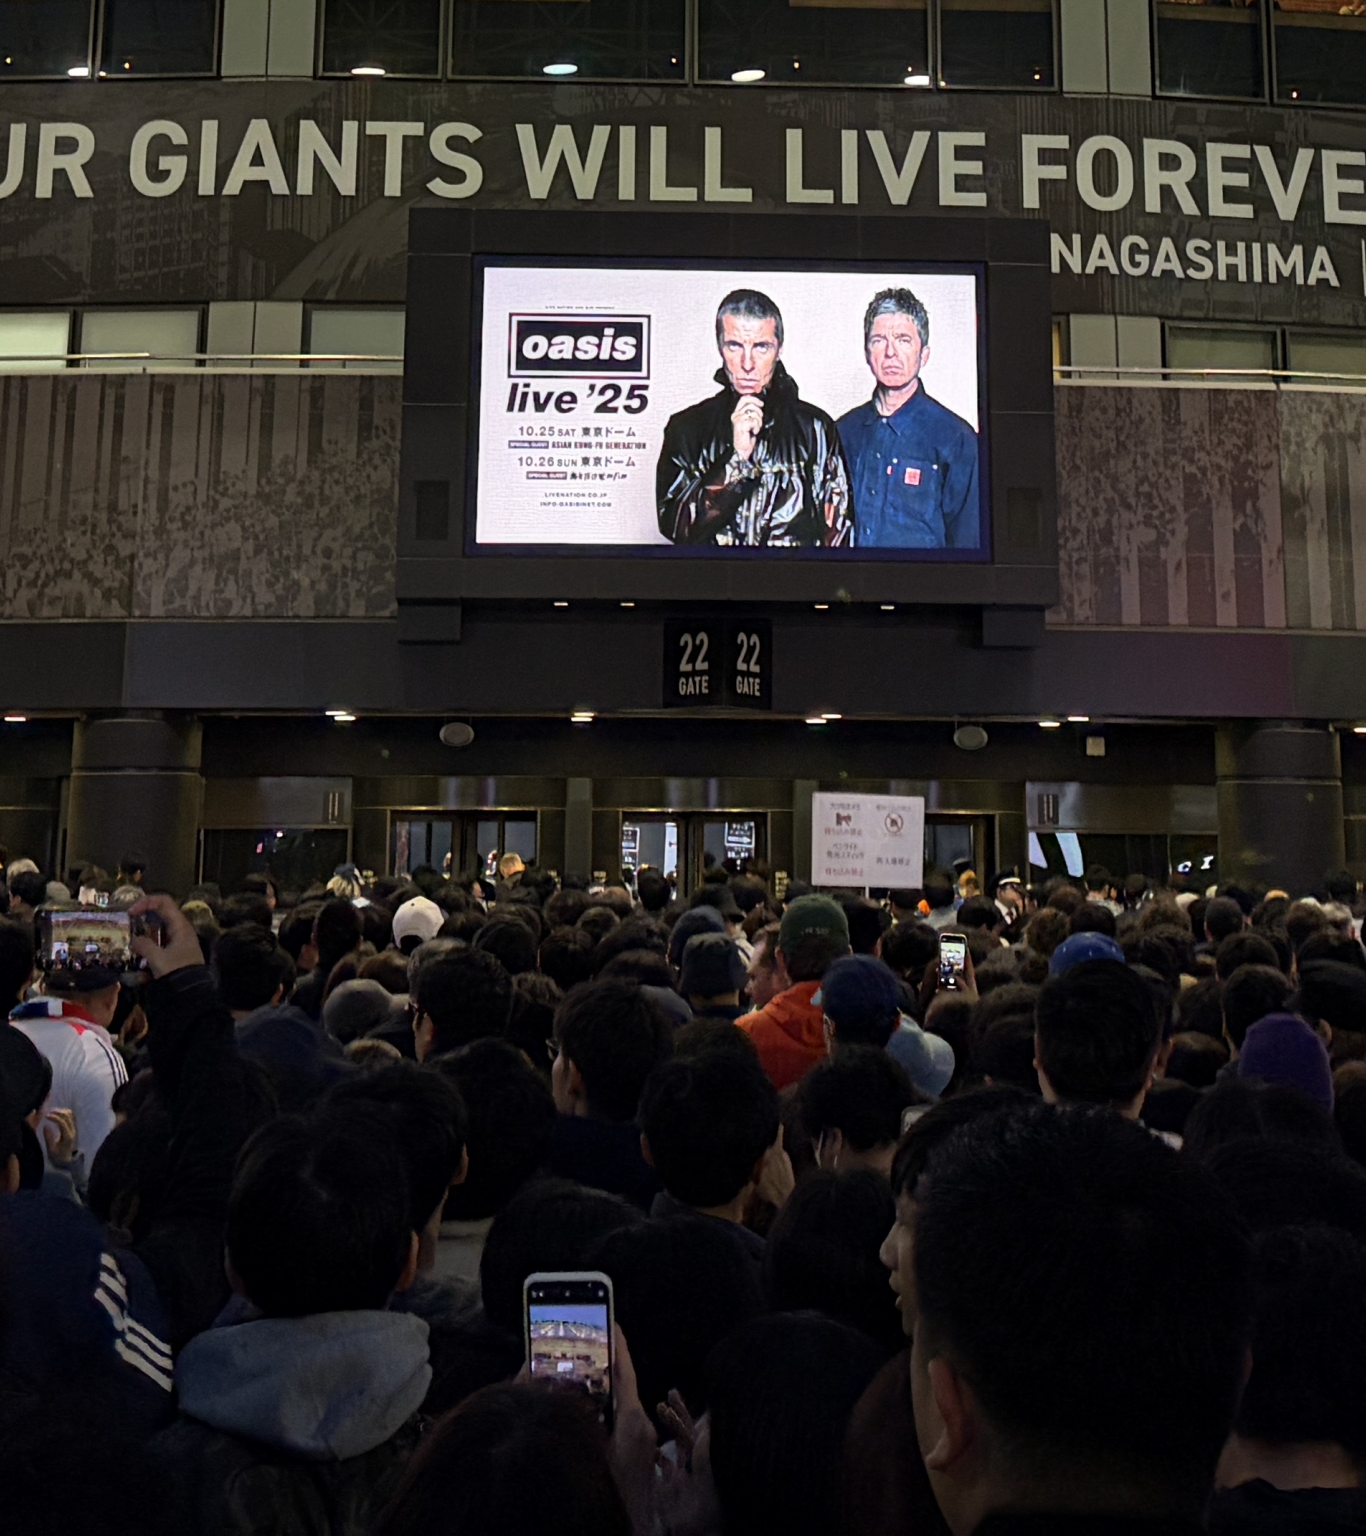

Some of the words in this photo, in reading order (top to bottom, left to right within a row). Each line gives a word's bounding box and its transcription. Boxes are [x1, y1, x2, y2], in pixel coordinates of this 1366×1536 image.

[129, 118, 484, 200] GIANTS
[515, 124, 752, 203] WILL
[785, 128, 988, 206] LIVE
[1051, 233, 1339, 288] NAGASHIMA
[522, 327, 637, 361] oasis
[506, 383, 578, 414] live
[586, 383, 650, 414] ’25
[518, 426, 556, 437] 10.25
[557, 428, 577, 437] SAT
[581, 426, 637, 438] 東京ドーム
[518, 456, 555, 467] 10.26
[557, 458, 578, 467] SUN
[580, 456, 636, 467] 東京ドーム
[679, 631, 709, 672] 22
[736, 631, 761, 673] 22
[678, 675, 709, 696] GATE
[736, 675, 761, 696] GATE
